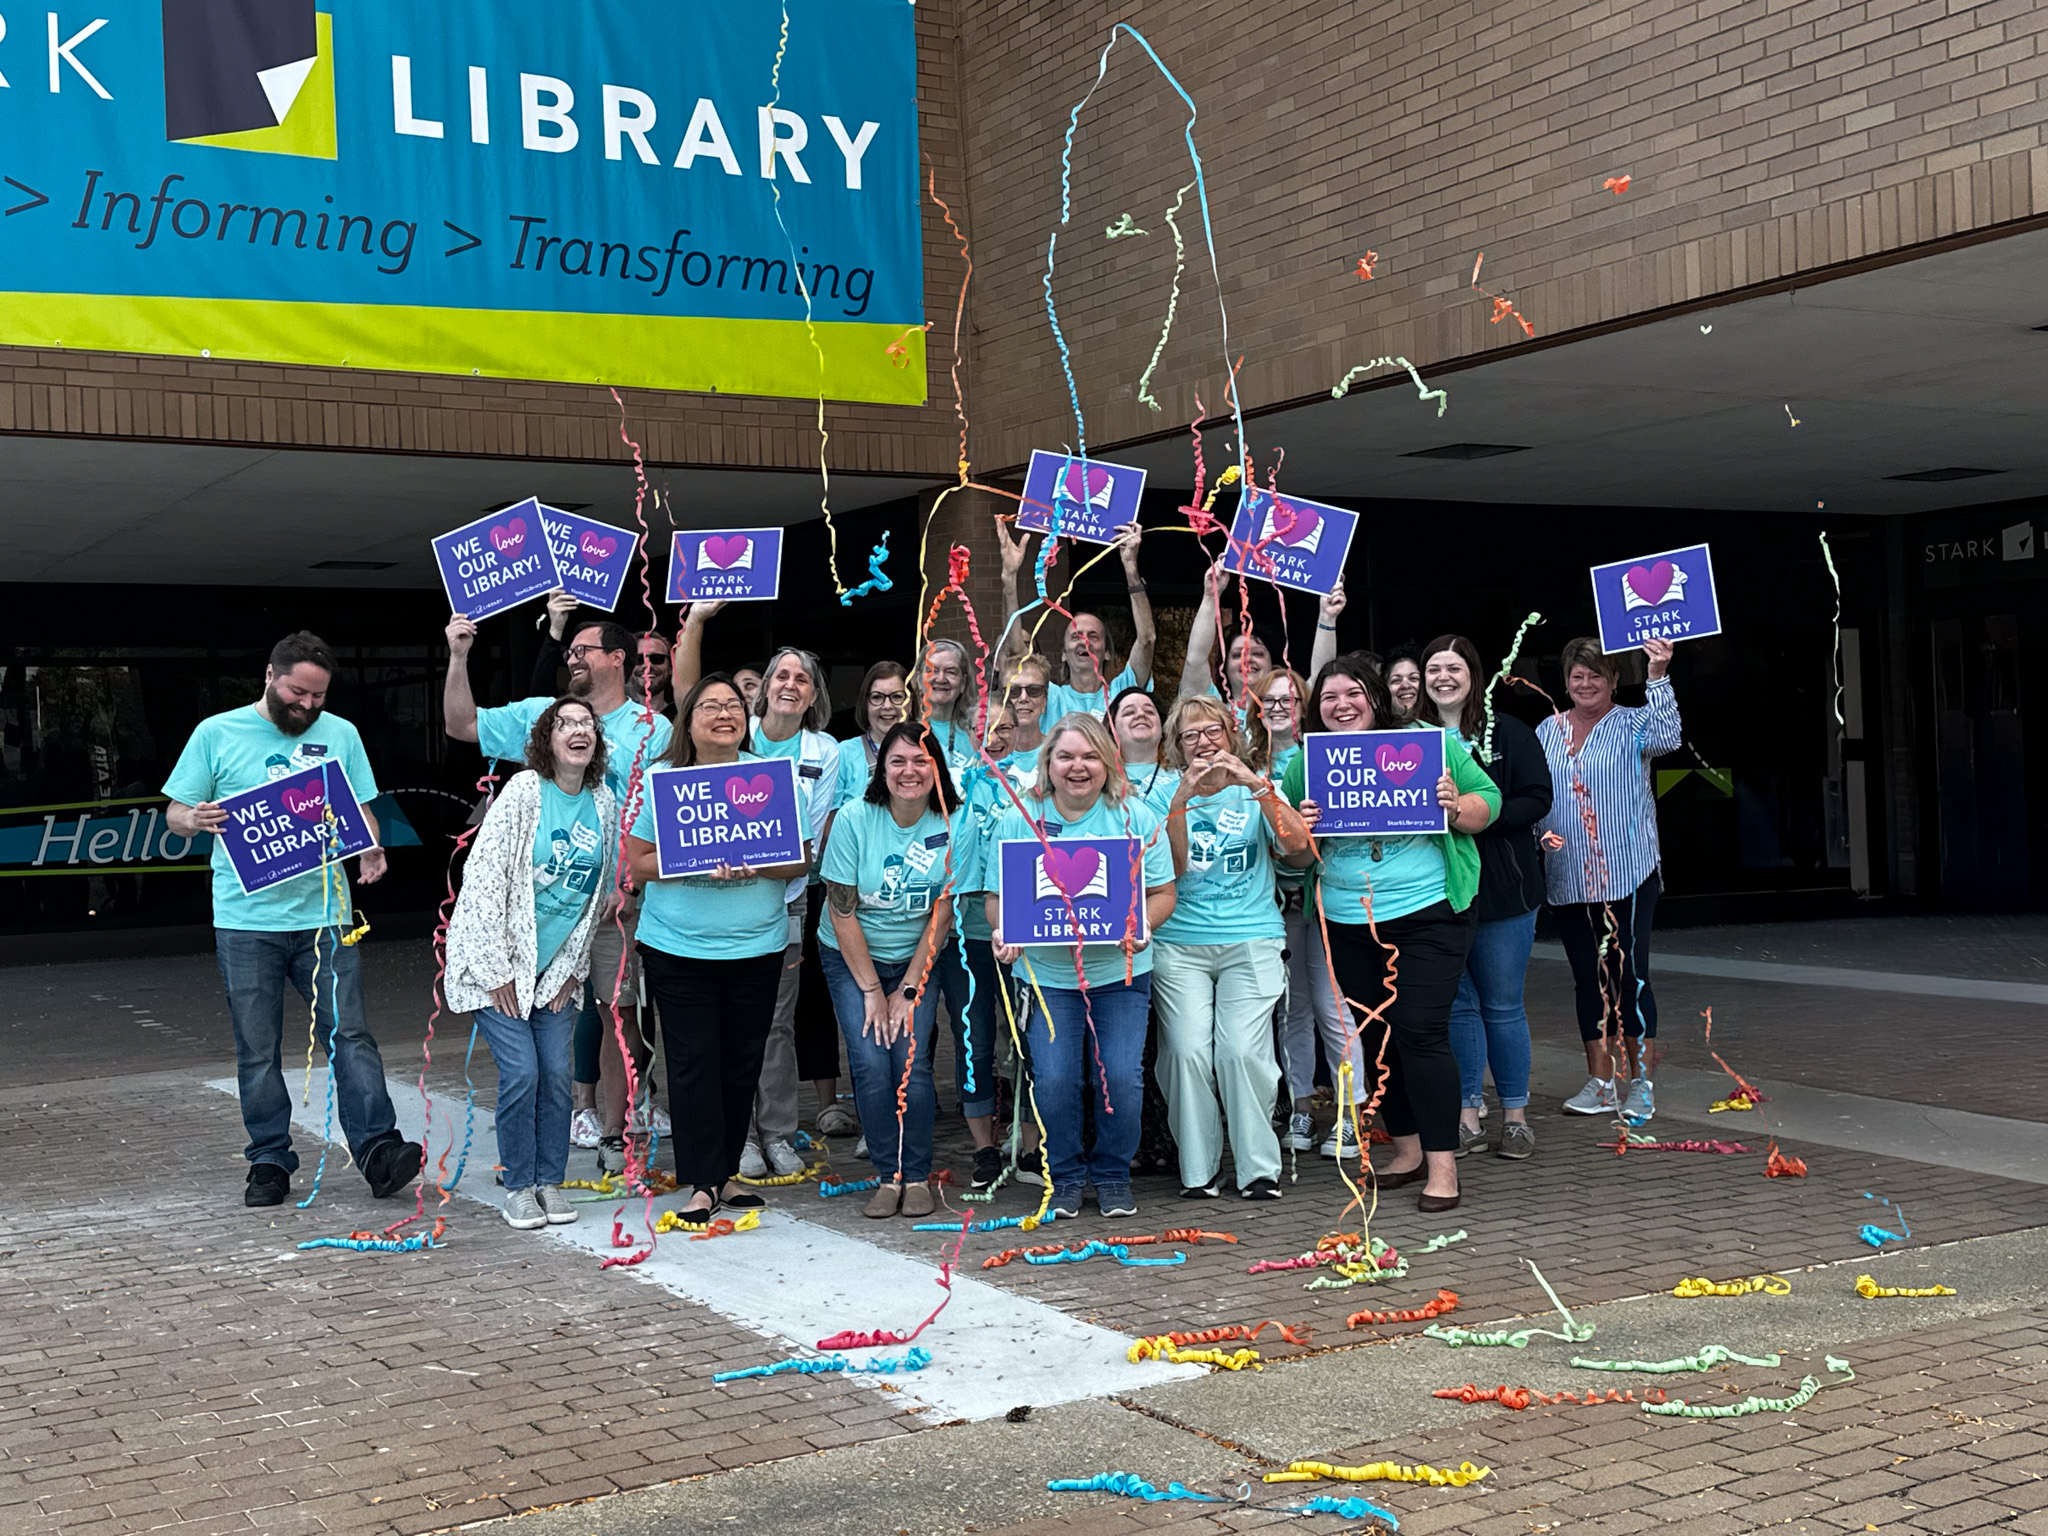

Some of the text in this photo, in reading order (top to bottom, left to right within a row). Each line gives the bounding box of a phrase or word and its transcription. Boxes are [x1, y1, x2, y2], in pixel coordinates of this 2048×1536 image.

[391, 54, 881, 190] LIBRARY
[71, 170, 418, 275] Informing
[508, 214, 875, 317] Transforming
[1042, 516, 1108, 537] LBRARY
[1063, 507, 1101, 524] TARK
[451, 533, 525, 561] WE love
[582, 536, 610, 558] love
[1925, 537, 1995, 563] STARK
[457, 550, 498, 579] OUR
[463, 553, 542, 598] LIBRARY!
[691, 585, 753, 596] LIBRARY
[701, 574, 745, 586] STARK
[1634, 609, 1682, 628] STARK
[1627, 620, 1692, 643] LIBRARY
[1325, 747, 1418, 772] WE love
[1326, 767, 1377, 788] OUR
[672, 780, 769, 805] WE love
[1327, 788, 1429, 810] LIBRARY!
[232, 795, 327, 826] WE love
[676, 802, 730, 825] OUR
[32, 807, 193, 866] Hello
[243, 813, 295, 844] OUR
[679, 819, 783, 848] LIBRARY!
[698, 857, 726, 866] LIBRARY
[1044, 906, 1102, 921] STARK
[1033, 922, 1113, 938] LIBRARY
